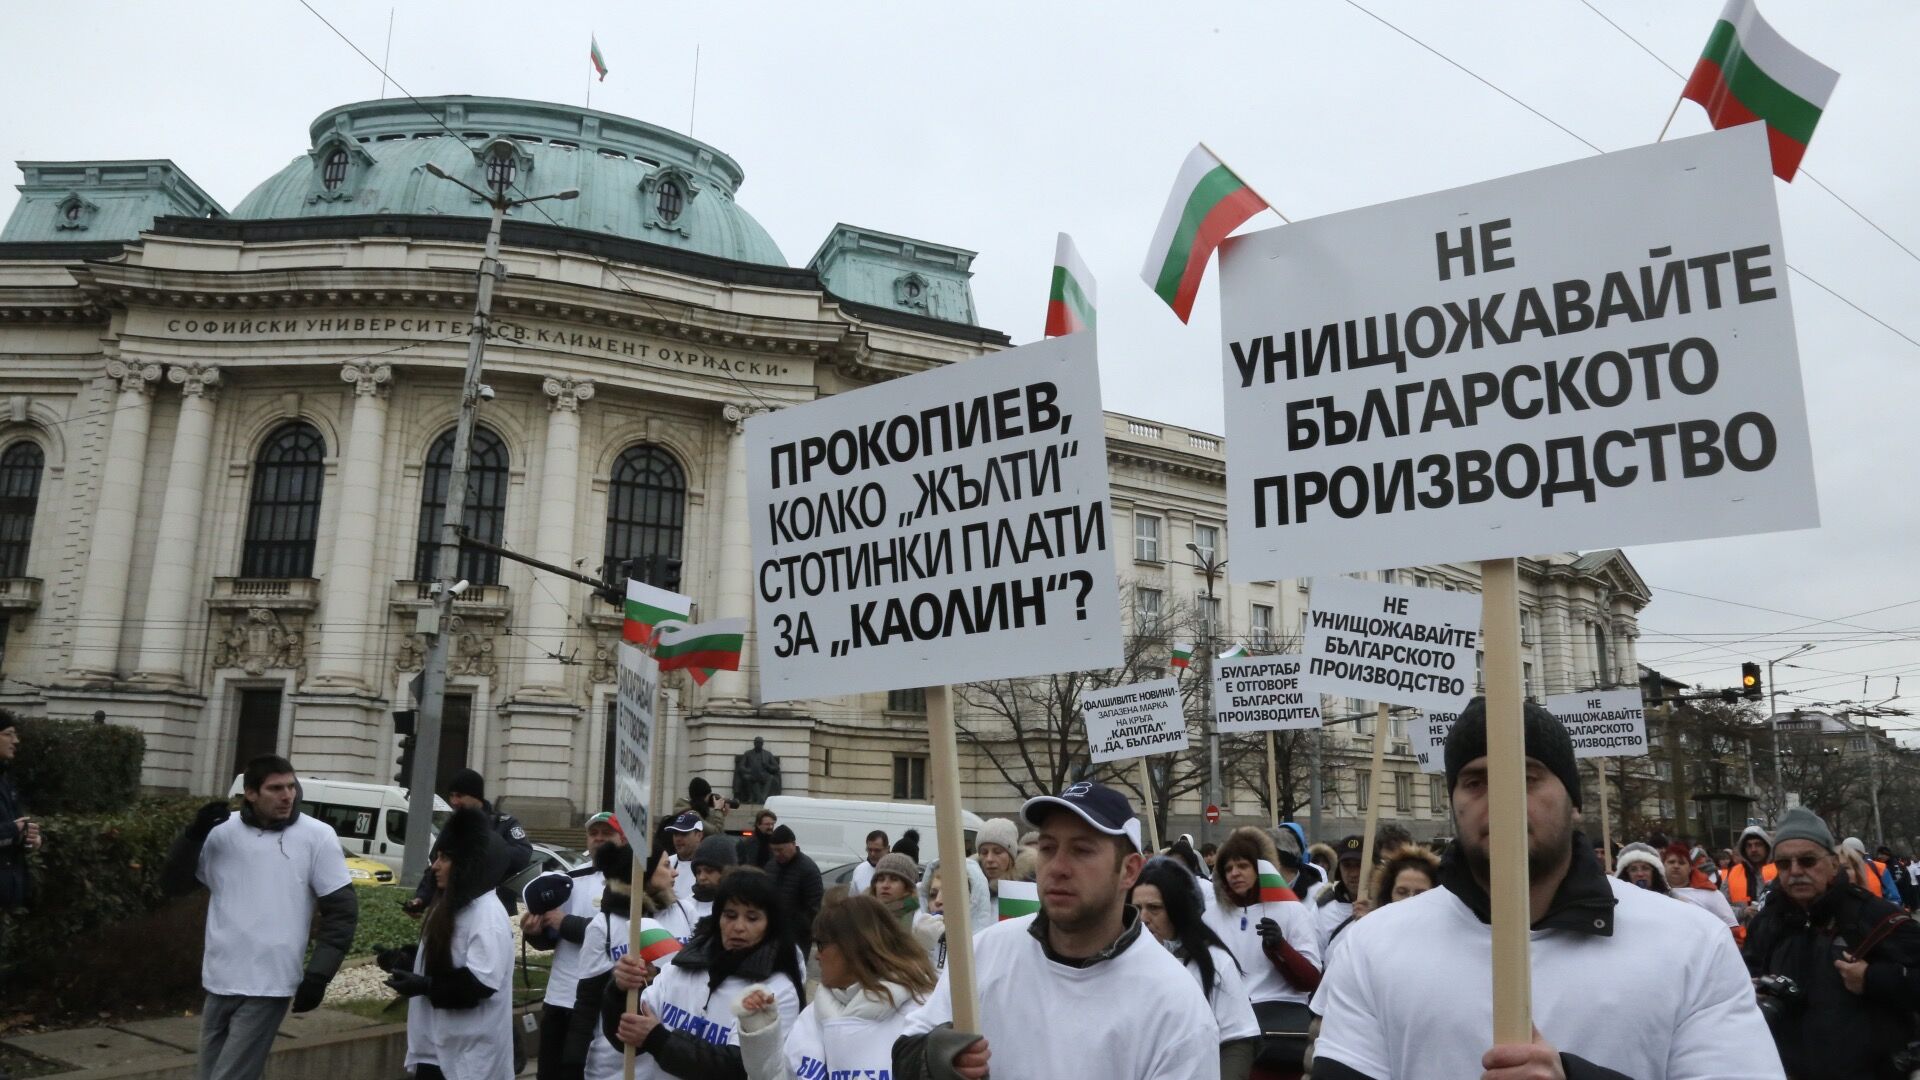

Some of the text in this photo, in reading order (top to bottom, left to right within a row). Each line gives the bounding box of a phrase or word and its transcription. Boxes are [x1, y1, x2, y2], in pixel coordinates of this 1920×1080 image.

[1435, 217, 1516, 281] НЕ
[1230, 244, 1777, 388] УНИЩОЖАВАЙТЕ
[168, 319, 297, 334] СОФИЙСКИ
[538, 329, 650, 357] КЛИМЕНТ
[1285, 337, 1719, 452] БЪЛГАРСКОТО
[770, 381, 1072, 489] ПРОКОПИЕВ,
[1253, 411, 1778, 529] ПРОИЗВОДСТВО
[769, 481, 886, 545] КОЛКО
[759, 500, 1106, 602] СТОТИНКИ ПЛАТИ
[1383, 596, 1409, 615] НЕ
[773, 611, 819, 658] ЗА
[1312, 610, 1476, 649] УНИЩОЖАВАЙТЕ
[1325, 636, 1455, 670] БЪЛГАРСКОТО
[1217, 662, 1300, 681] „БУЛГАРТАБА
[1309, 657, 1465, 696] ПРОИЗВОДСТВО
[1226, 678, 1298, 693] Е ОТГОВОРЕ
[1084, 693, 1137, 712] ФАЛШИВИТЕ
[1232, 692, 1303, 707] БЪЛГАРСКИ
[1587, 699, 1602, 709] НЕ
[1098, 701, 1168, 719] ЗАПАЗЕНА МАРКА
[1218, 707, 1320, 723] ПРОИЗВОДИТЕЛ
[1430, 712, 1458, 723] РАБО
[1555, 707, 1642, 724] НИЩОЖАВАЙТЕ
[1116, 714, 1153, 727] НА КРЪГА
[1429, 725, 1443, 735] НЕ
[1567, 723, 1634, 735] ЪЛГАРСКОТО
[1091, 744, 1098, 754] И
[1572, 735, 1642, 748] ОИЗВОДСТВО
